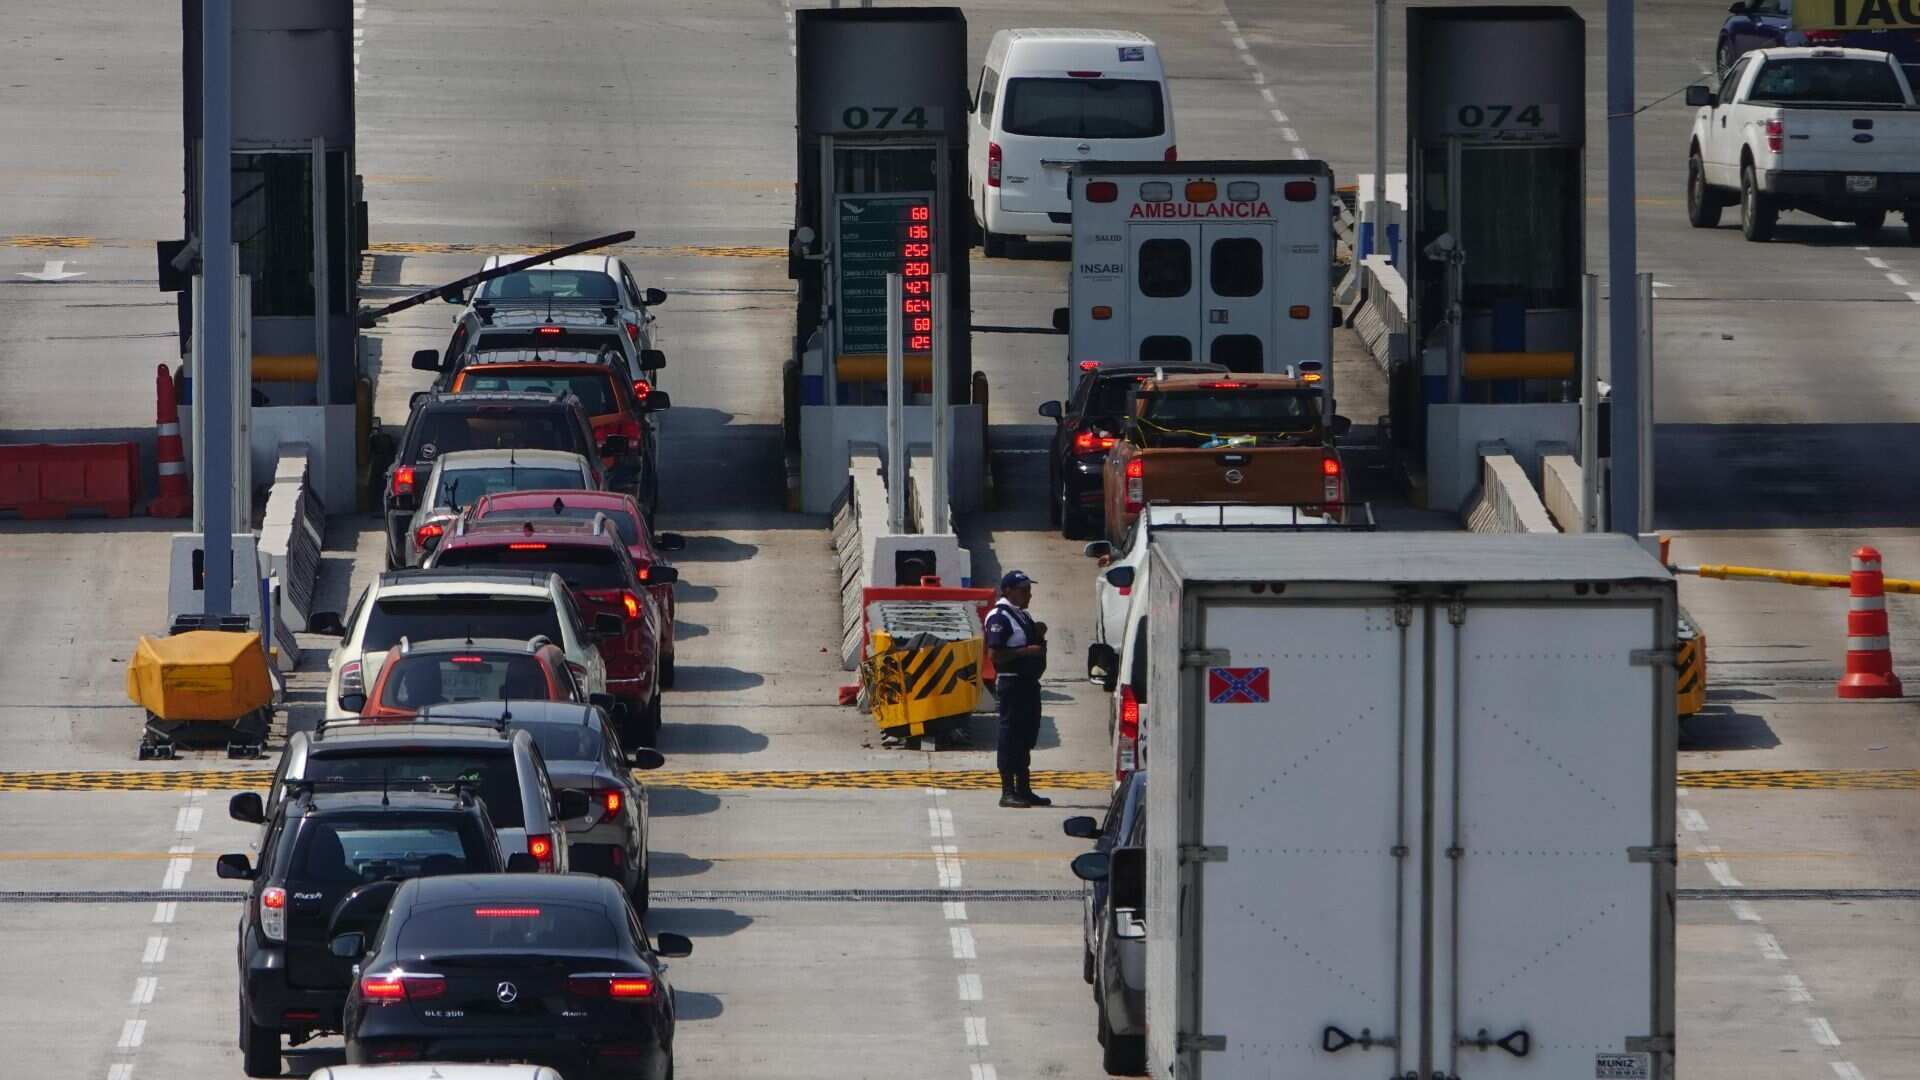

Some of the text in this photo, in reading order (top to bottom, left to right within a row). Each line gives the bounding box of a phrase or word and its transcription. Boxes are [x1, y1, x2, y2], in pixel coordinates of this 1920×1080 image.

[842, 106, 928, 129] 074
[1457, 104, 1544, 128] 074
[912, 207, 929, 220] 68
[1129, 202, 1271, 218] AMBULANCIA
[909, 225, 929, 239] 136
[1095, 234, 1122, 242] SALUD
[905, 243, 929, 257] 252
[905, 262, 929, 276] 250
[1080, 263, 1123, 273] INSABI
[906, 281, 929, 294] 427
[906, 299, 930, 313] 624
[914, 318, 930, 331] 68
[911, 336, 931, 349] 125
